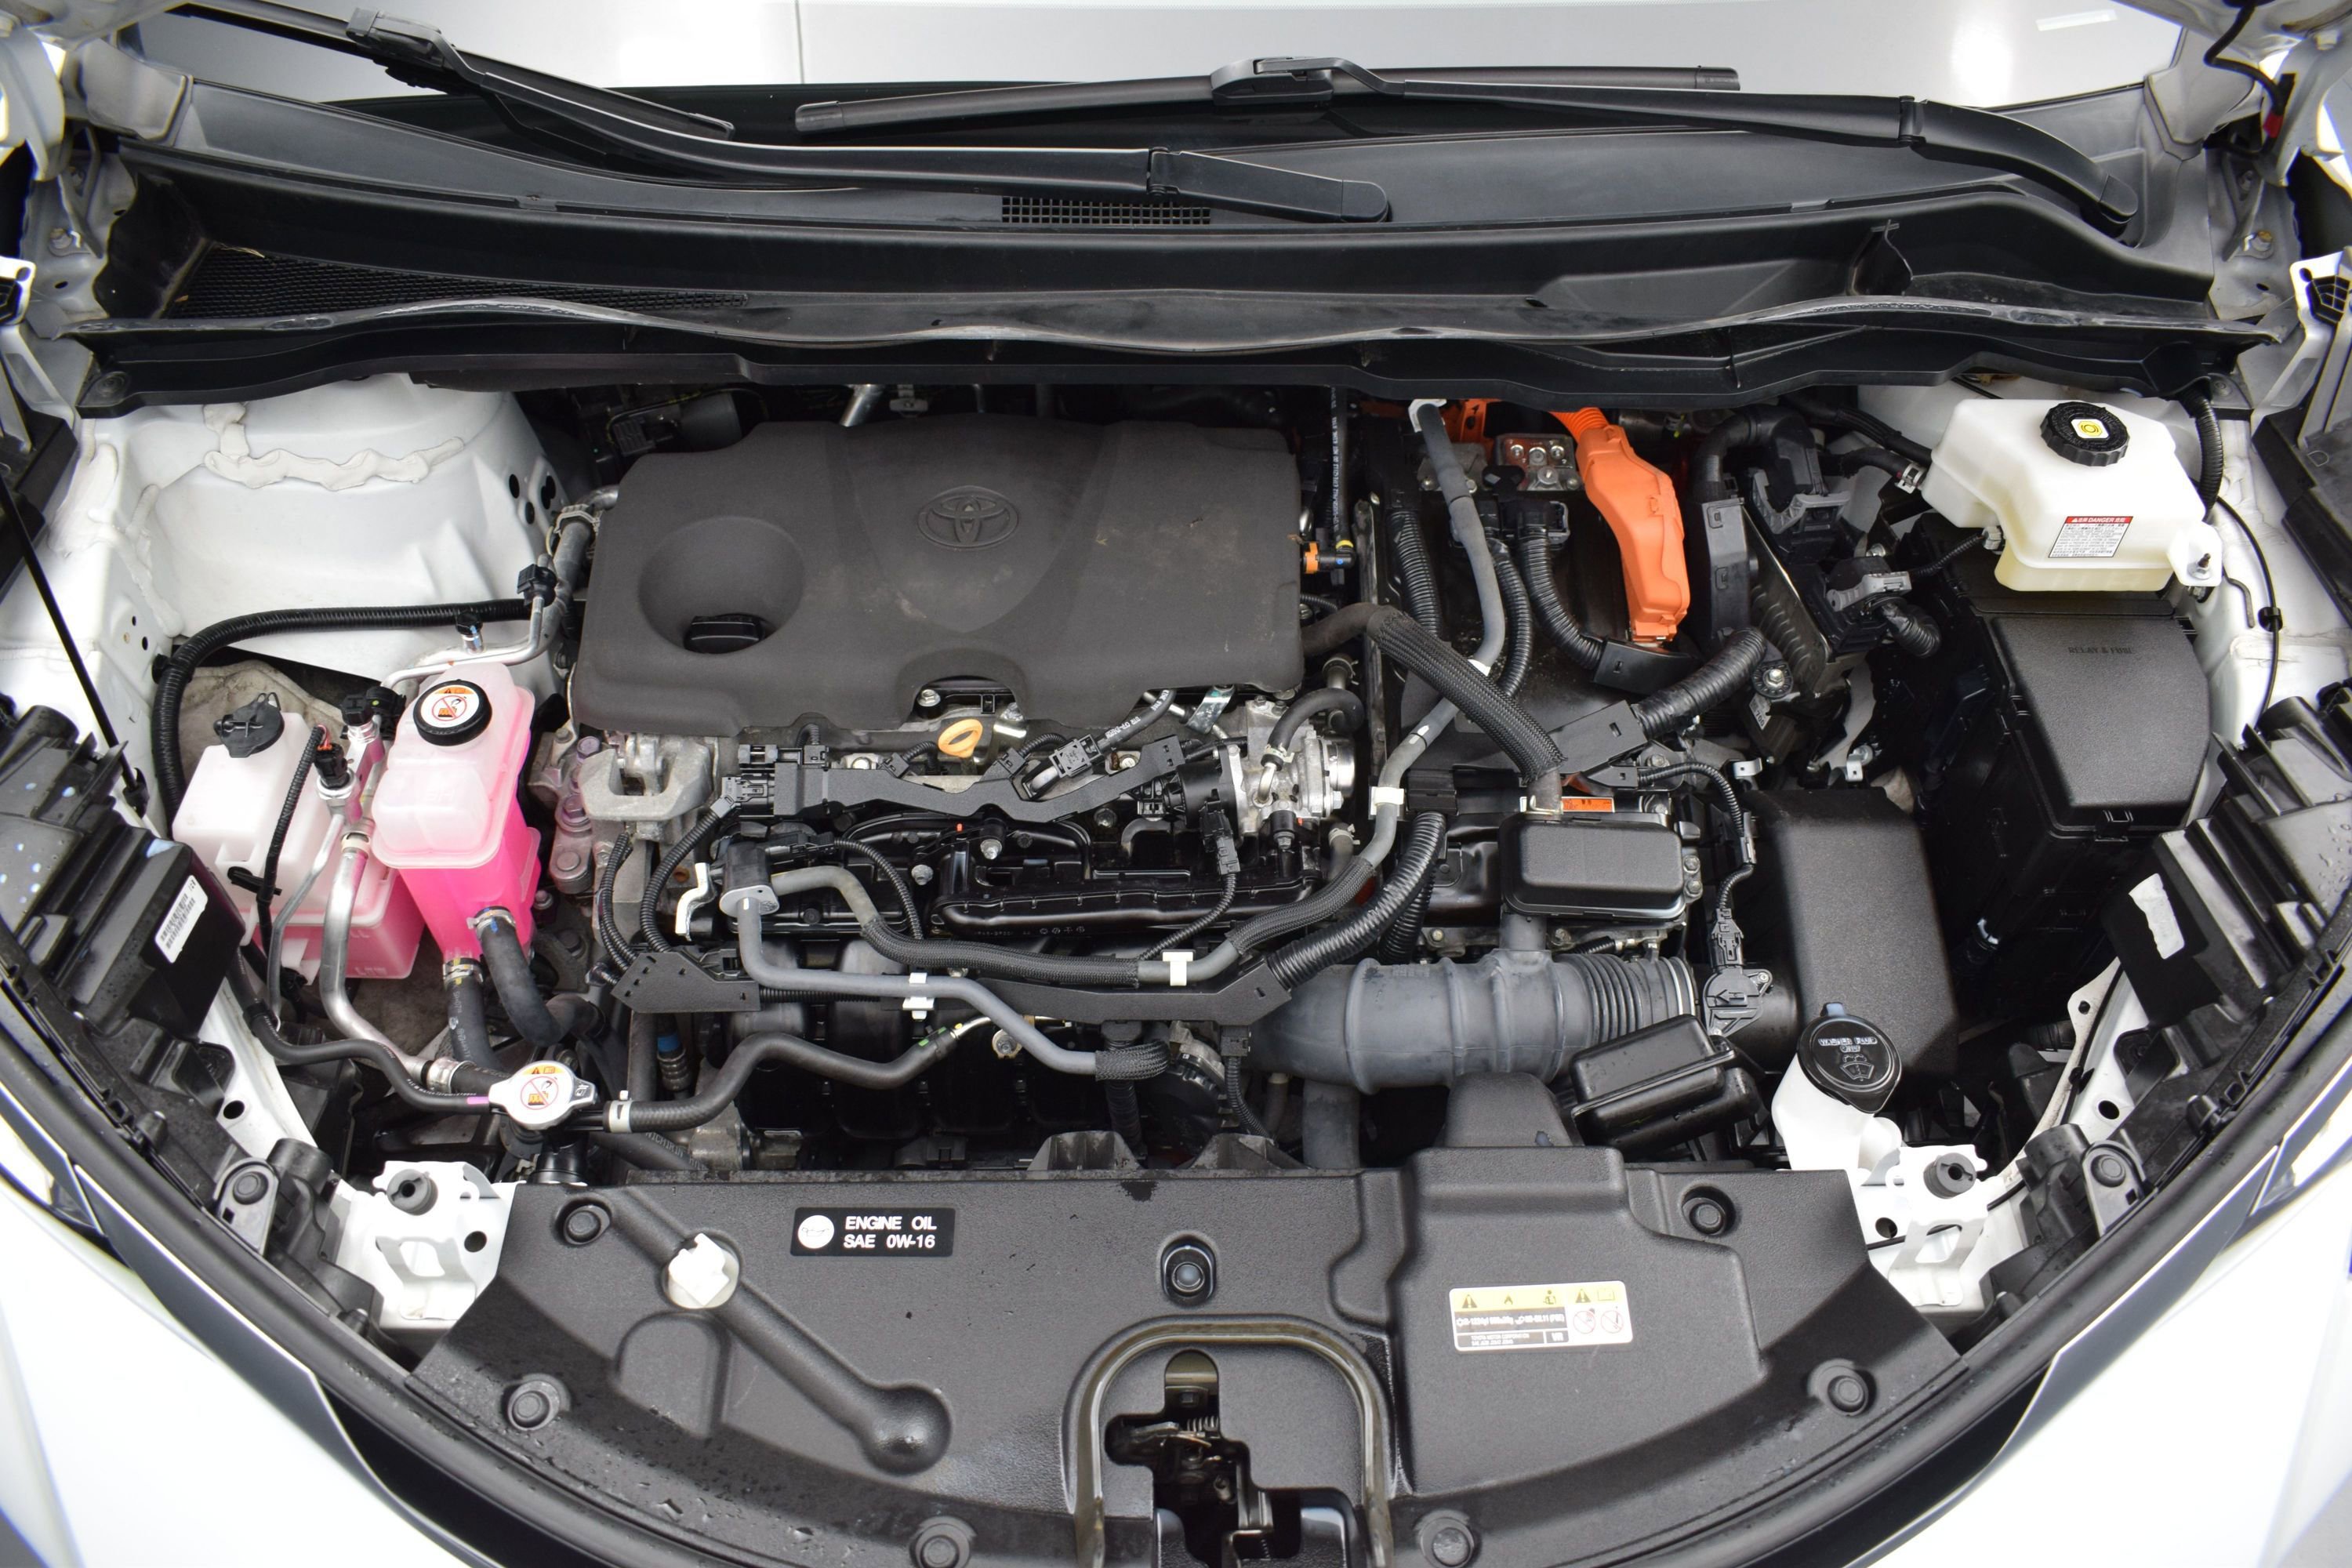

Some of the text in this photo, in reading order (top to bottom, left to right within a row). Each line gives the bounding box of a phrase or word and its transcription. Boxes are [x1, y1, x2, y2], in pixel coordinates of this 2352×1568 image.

[844, 1216, 938, 1230] ENGINE OIL
[843, 1234, 936, 1248] SAE 0W-16
